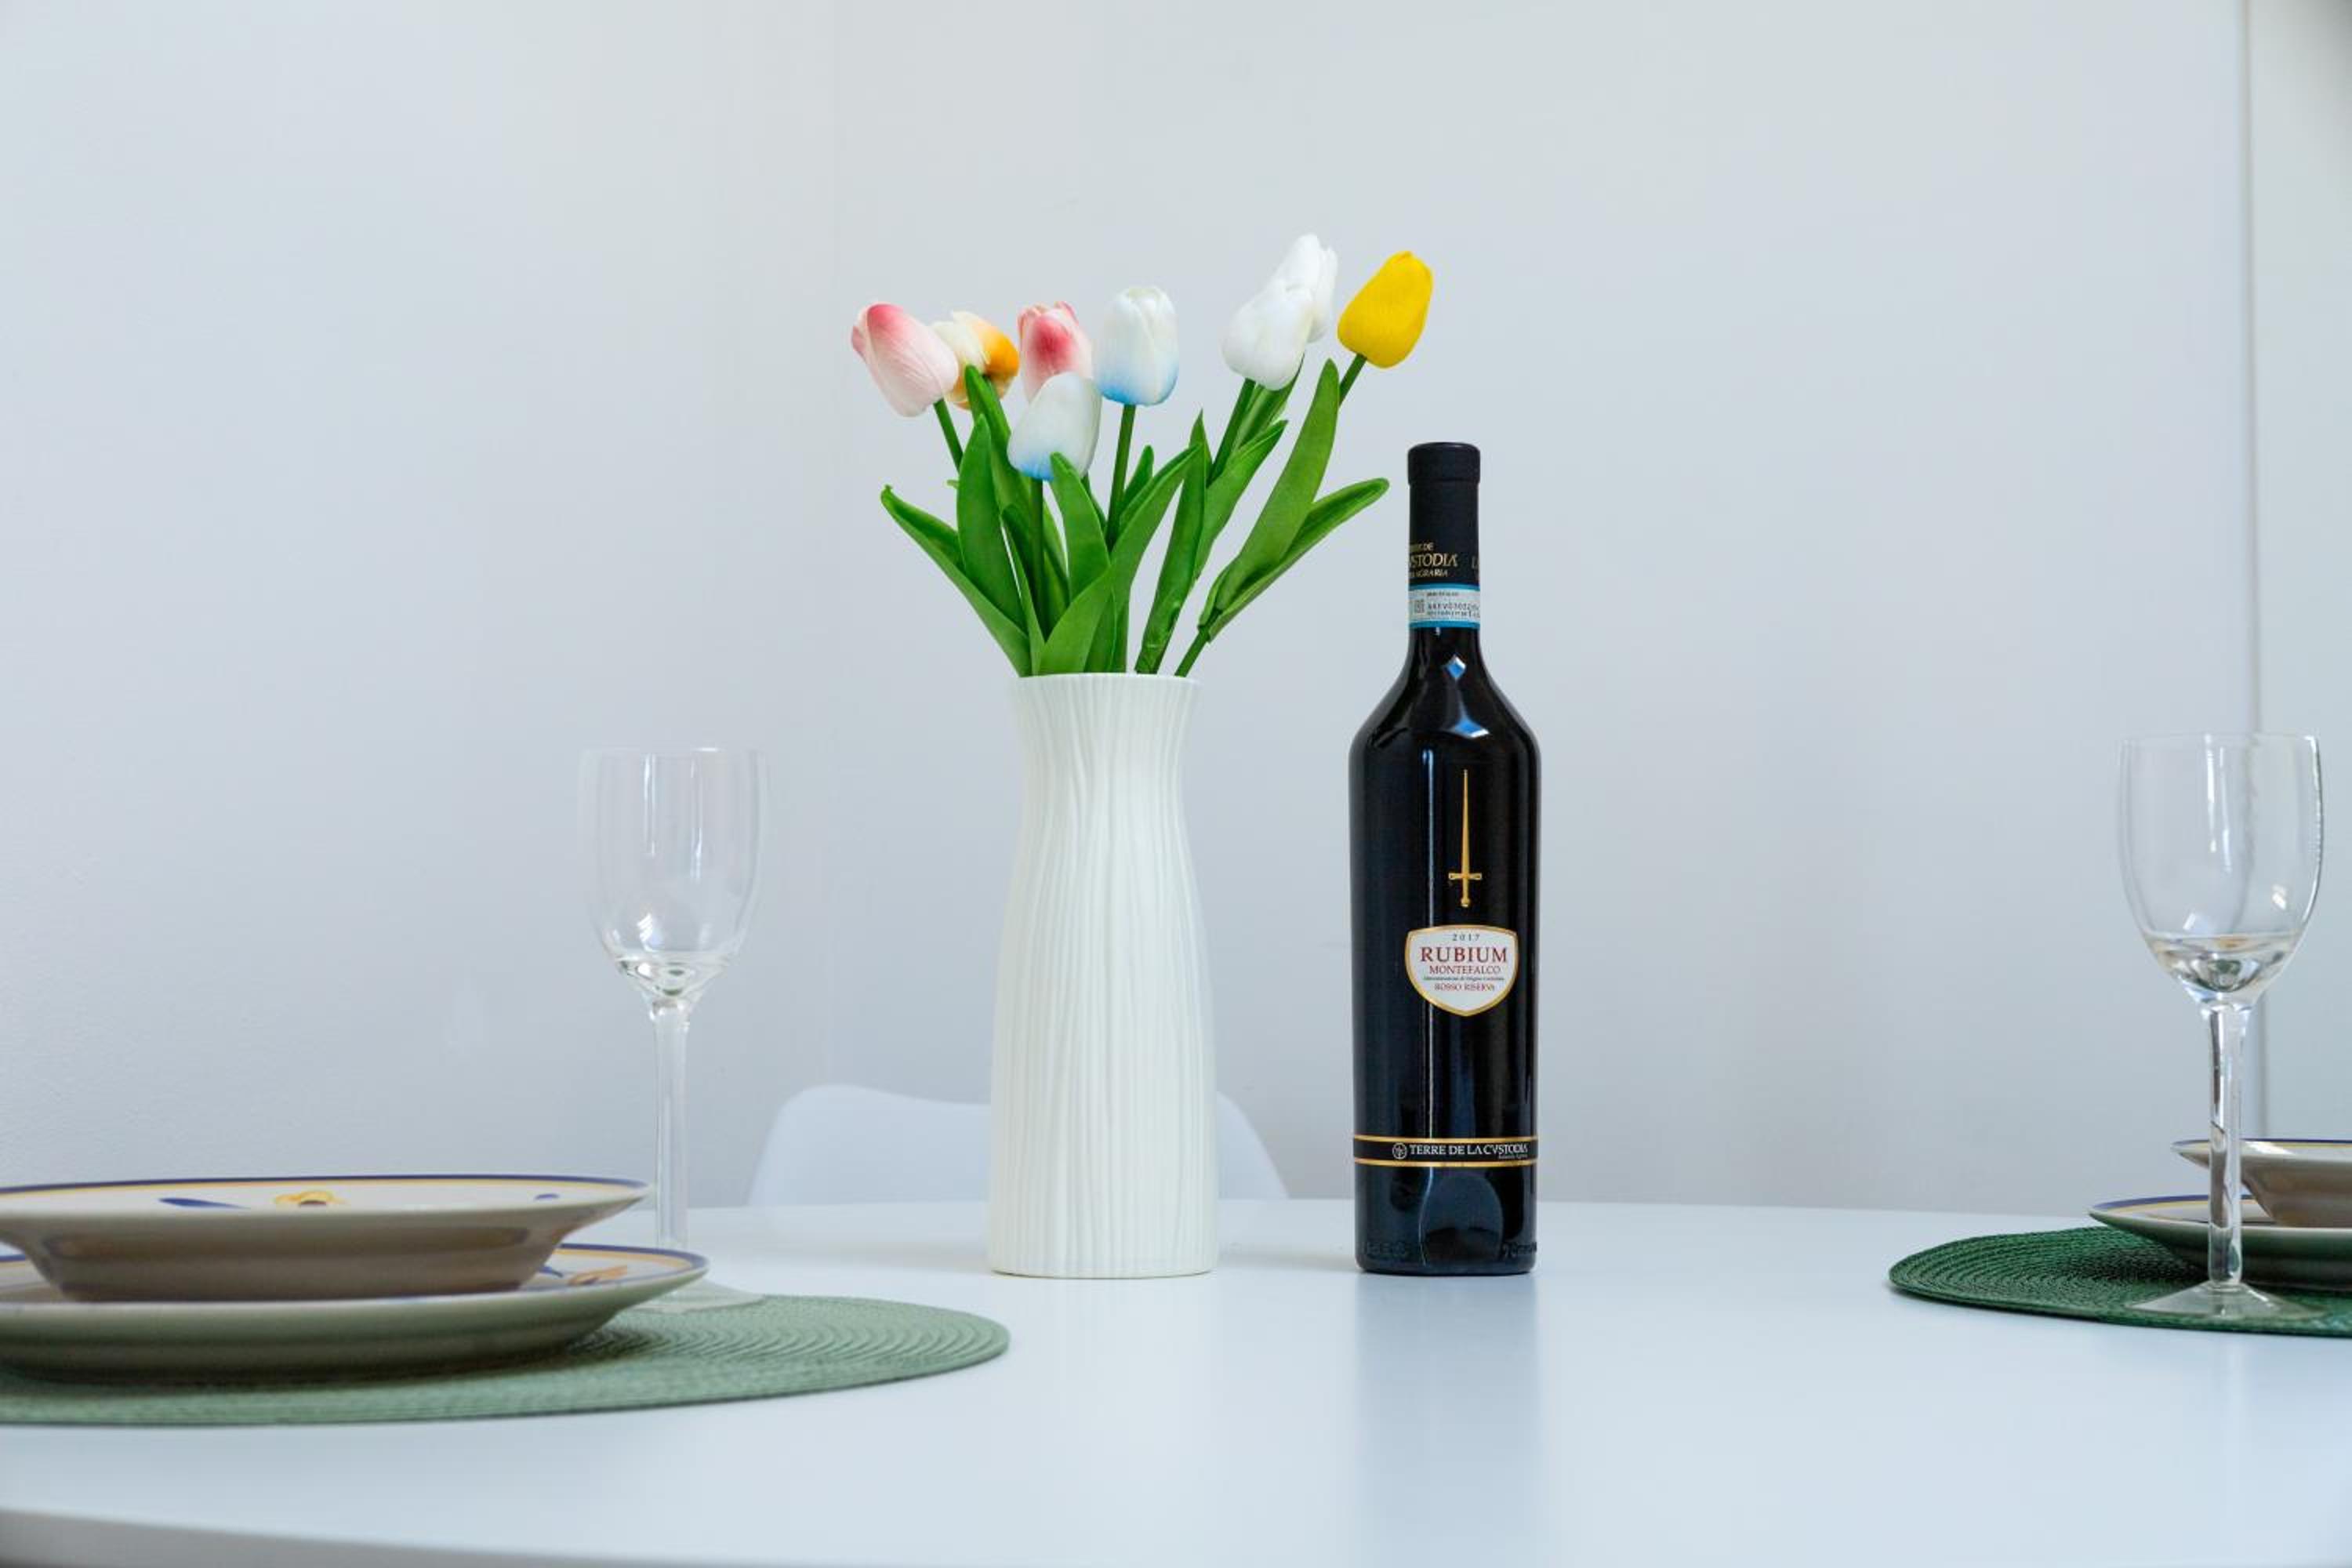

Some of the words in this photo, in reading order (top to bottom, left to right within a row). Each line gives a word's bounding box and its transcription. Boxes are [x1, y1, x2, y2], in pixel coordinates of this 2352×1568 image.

[1409, 553, 1458, 568] STODIA
[1452, 932, 1480, 942] 2017
[1420, 946, 1507, 963] RUBIUM
[1429, 965, 1501, 975] MONTEFALCO
[1410, 1145, 1446, 1155] TERRE
[1449, 1145, 1465, 1155] DE
